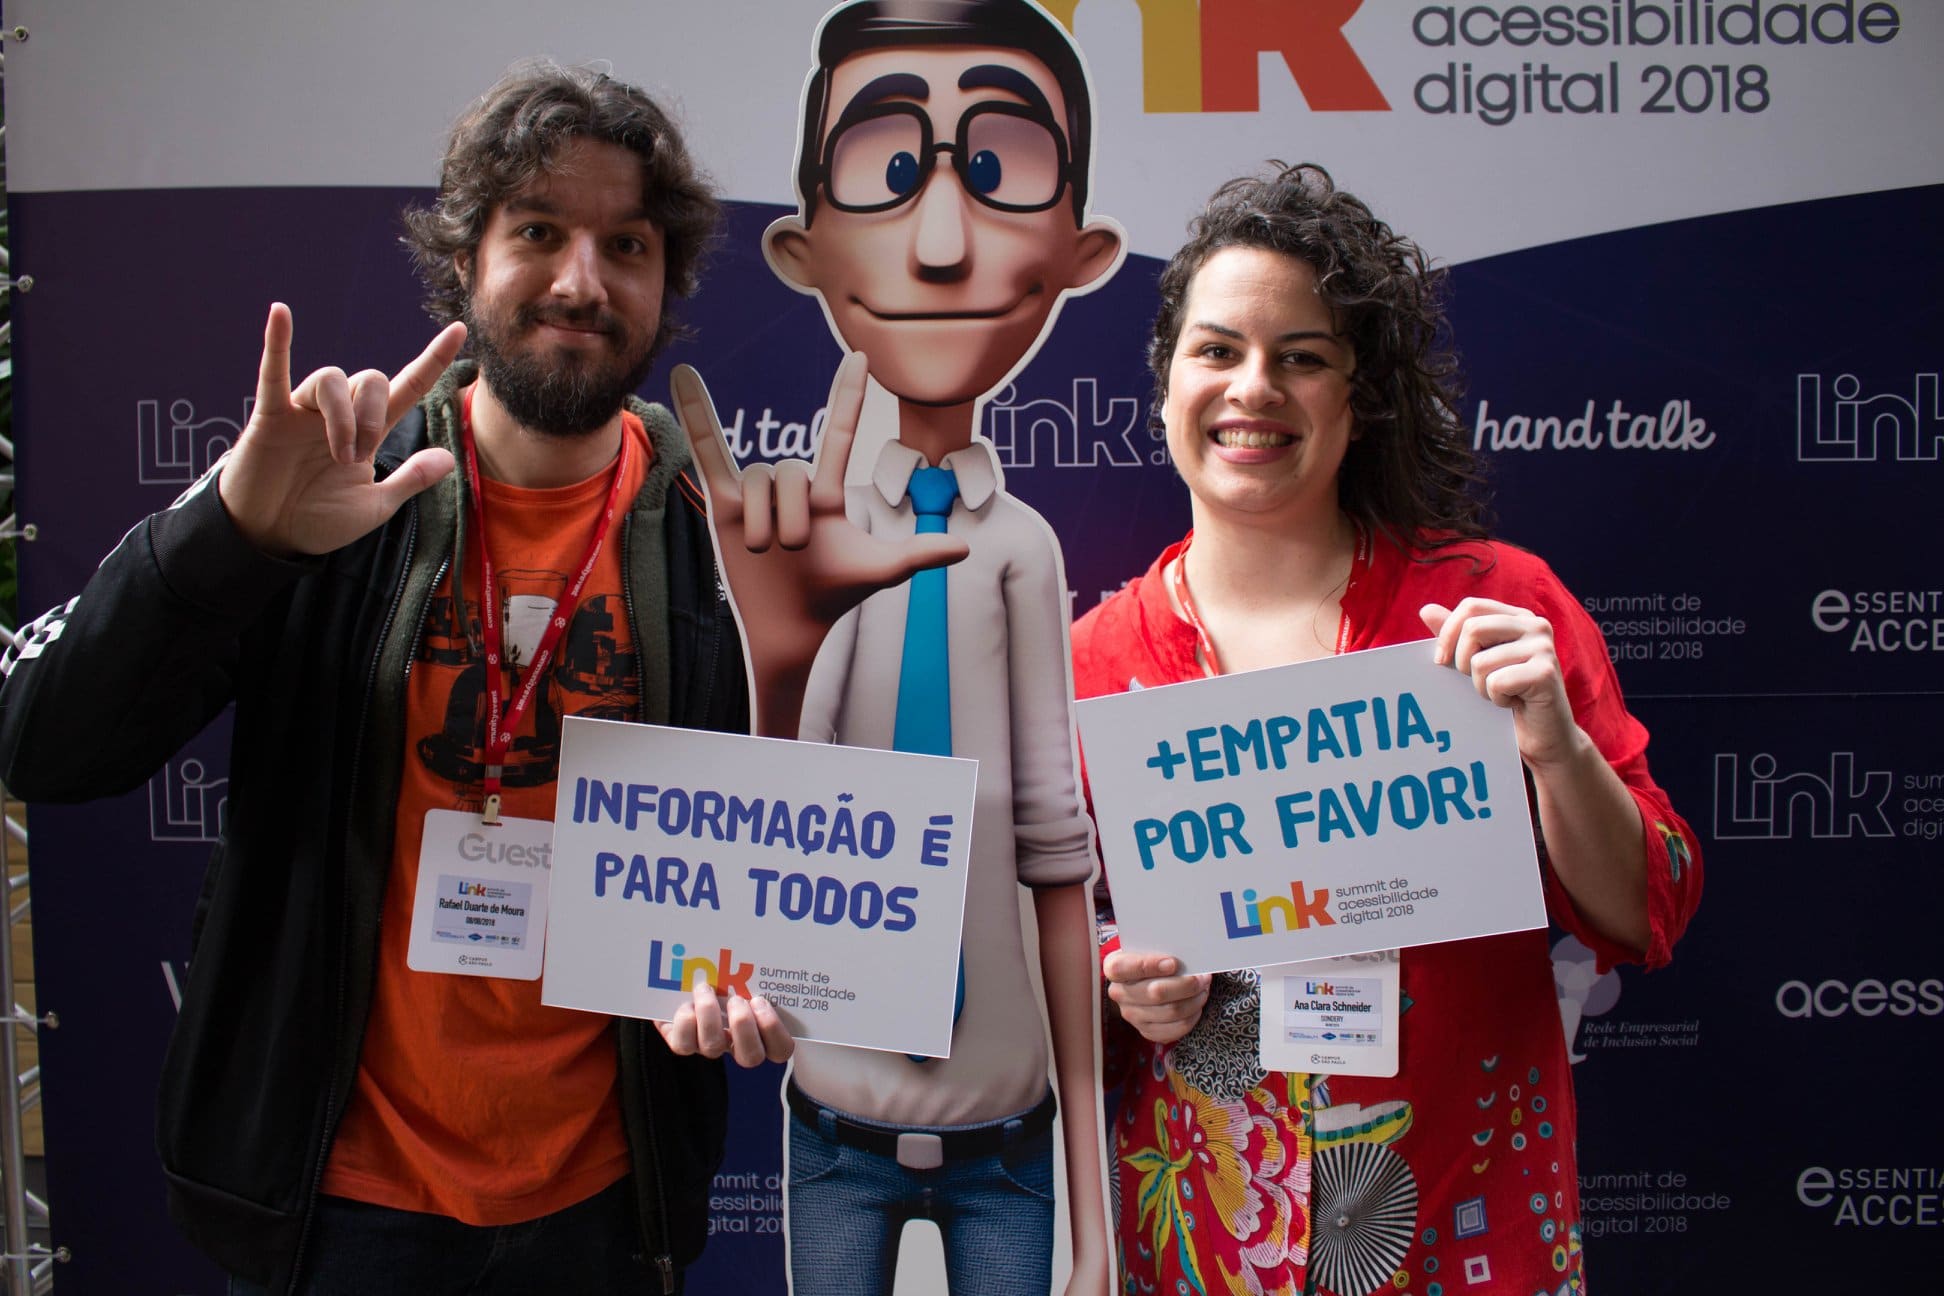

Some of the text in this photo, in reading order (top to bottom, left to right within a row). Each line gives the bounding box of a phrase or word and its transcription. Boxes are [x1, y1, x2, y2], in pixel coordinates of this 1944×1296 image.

[1412, 0, 1899, 46] acessibilidade
[1413, 62, 1771, 126] digital 2018
[992, 378, 1143, 468] ink
[1473, 400, 1717, 451] hand talk
[1584, 593, 1702, 612] summit de
[1597, 616, 1746, 635] cessibilidade
[1607, 642, 1704, 664] gital 2018
[1146, 692, 1451, 783] +EMPATIA,
[1714, 752, 1896, 839] Link
[572, 777, 954, 867] INFORMAÇÃO É
[1133, 760, 1493, 871] POR FAVOR!
[458, 833, 553, 869] Guest
[458, 881, 487, 897] Link
[594, 852, 920, 932] PARA TODOS
[1336, 877, 1409, 898] summit de
[439, 898, 525, 917] Rafael Duarte de Moura
[1338, 886, 1439, 911] acessibilidade
[1219, 880, 1337, 939] Link
[1340, 904, 1415, 925] digital 2018
[647, 940, 755, 1000] Link
[759, 966, 830, 984] summit de
[759, 980, 856, 1001] acessibilidade
[1306, 981, 1334, 995] Link
[1775, 978, 1944, 1018] acess
[802, 998, 829, 1012] 2018
[1294, 1000, 1372, 1013] Ana Clara Schneider
[1584, 1020, 1700, 1036] Rede Empresarial
[1584, 1034, 1700, 1048] de Inclusão Social
[765, 1173, 782, 1189] d
[1576, 1171, 1688, 1189] summit de
[1834, 1195, 1944, 1226] ACCE
[708, 1215, 749, 1235] gital
[1645, 1216, 1688, 1233] 2018
